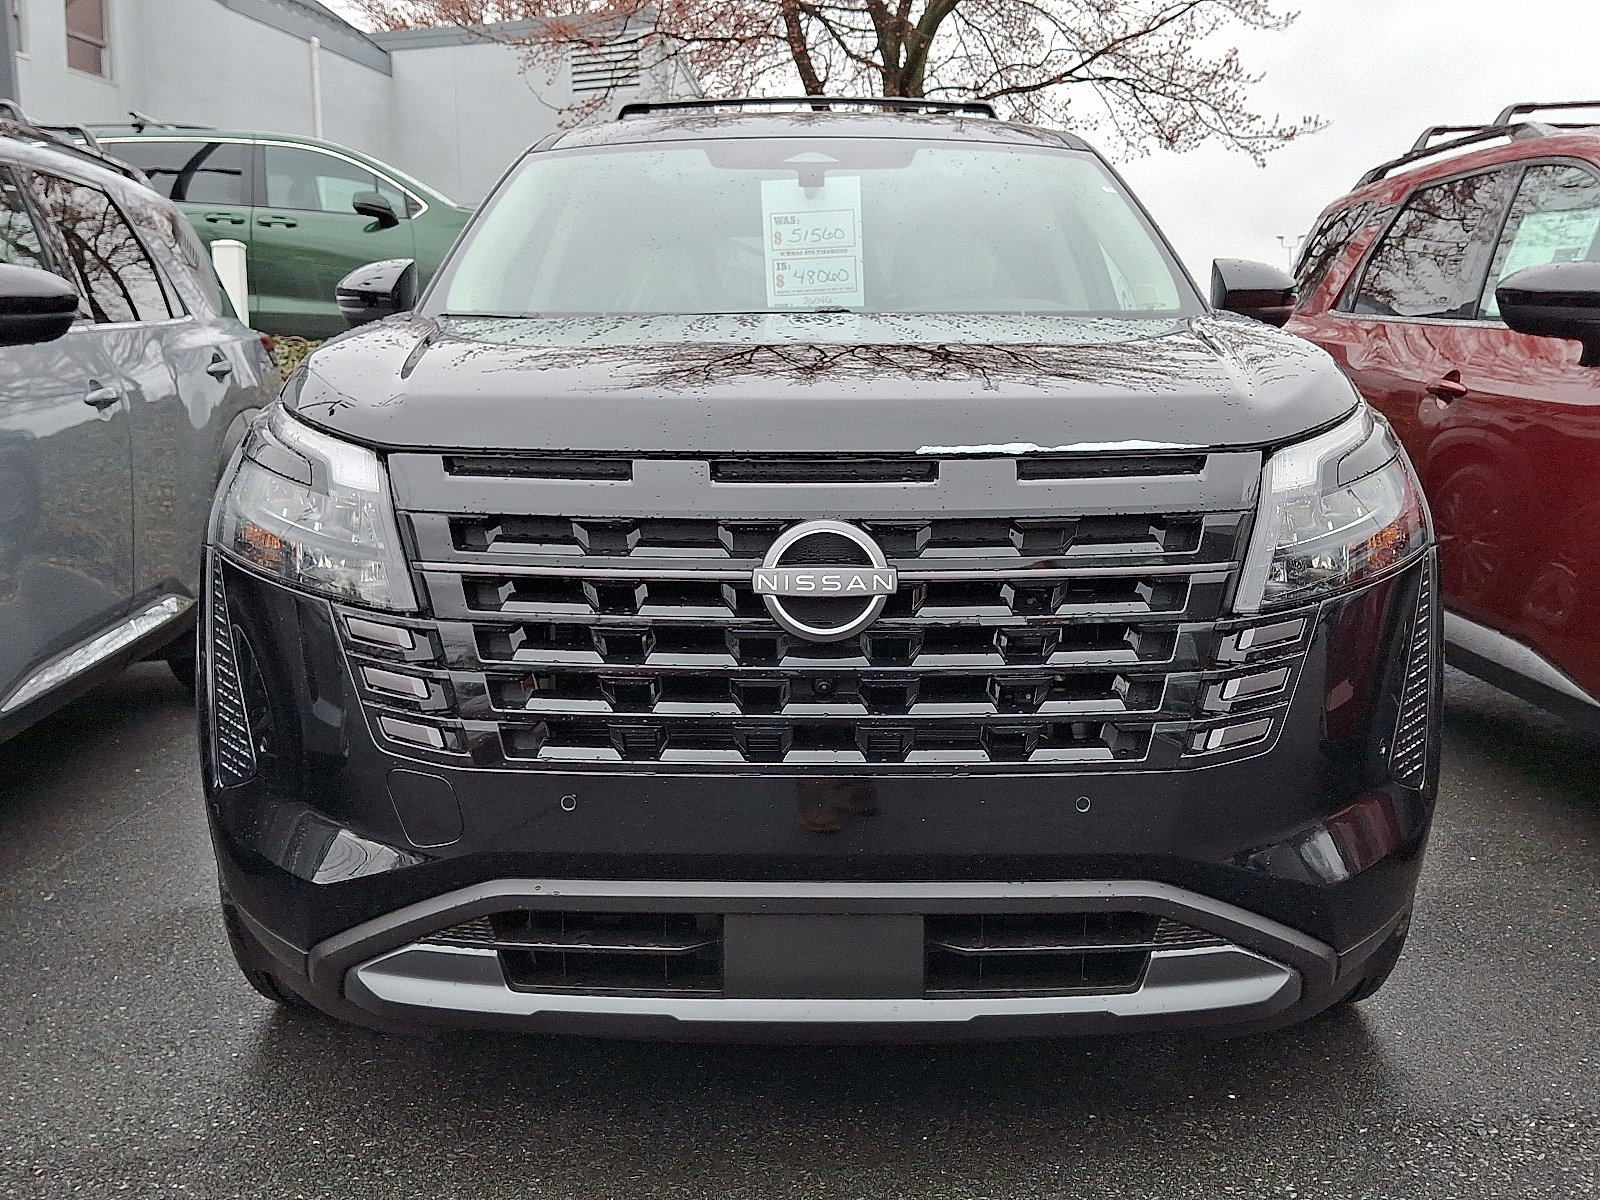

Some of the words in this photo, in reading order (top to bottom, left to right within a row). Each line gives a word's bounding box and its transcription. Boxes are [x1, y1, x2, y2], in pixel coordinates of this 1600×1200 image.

[773, 215, 800, 225] WAS:
[787, 227, 845, 243] 51560
[775, 262, 791, 271] IS:
[793, 269, 849, 285] 48060
[757, 574, 892, 591] NISSAN
